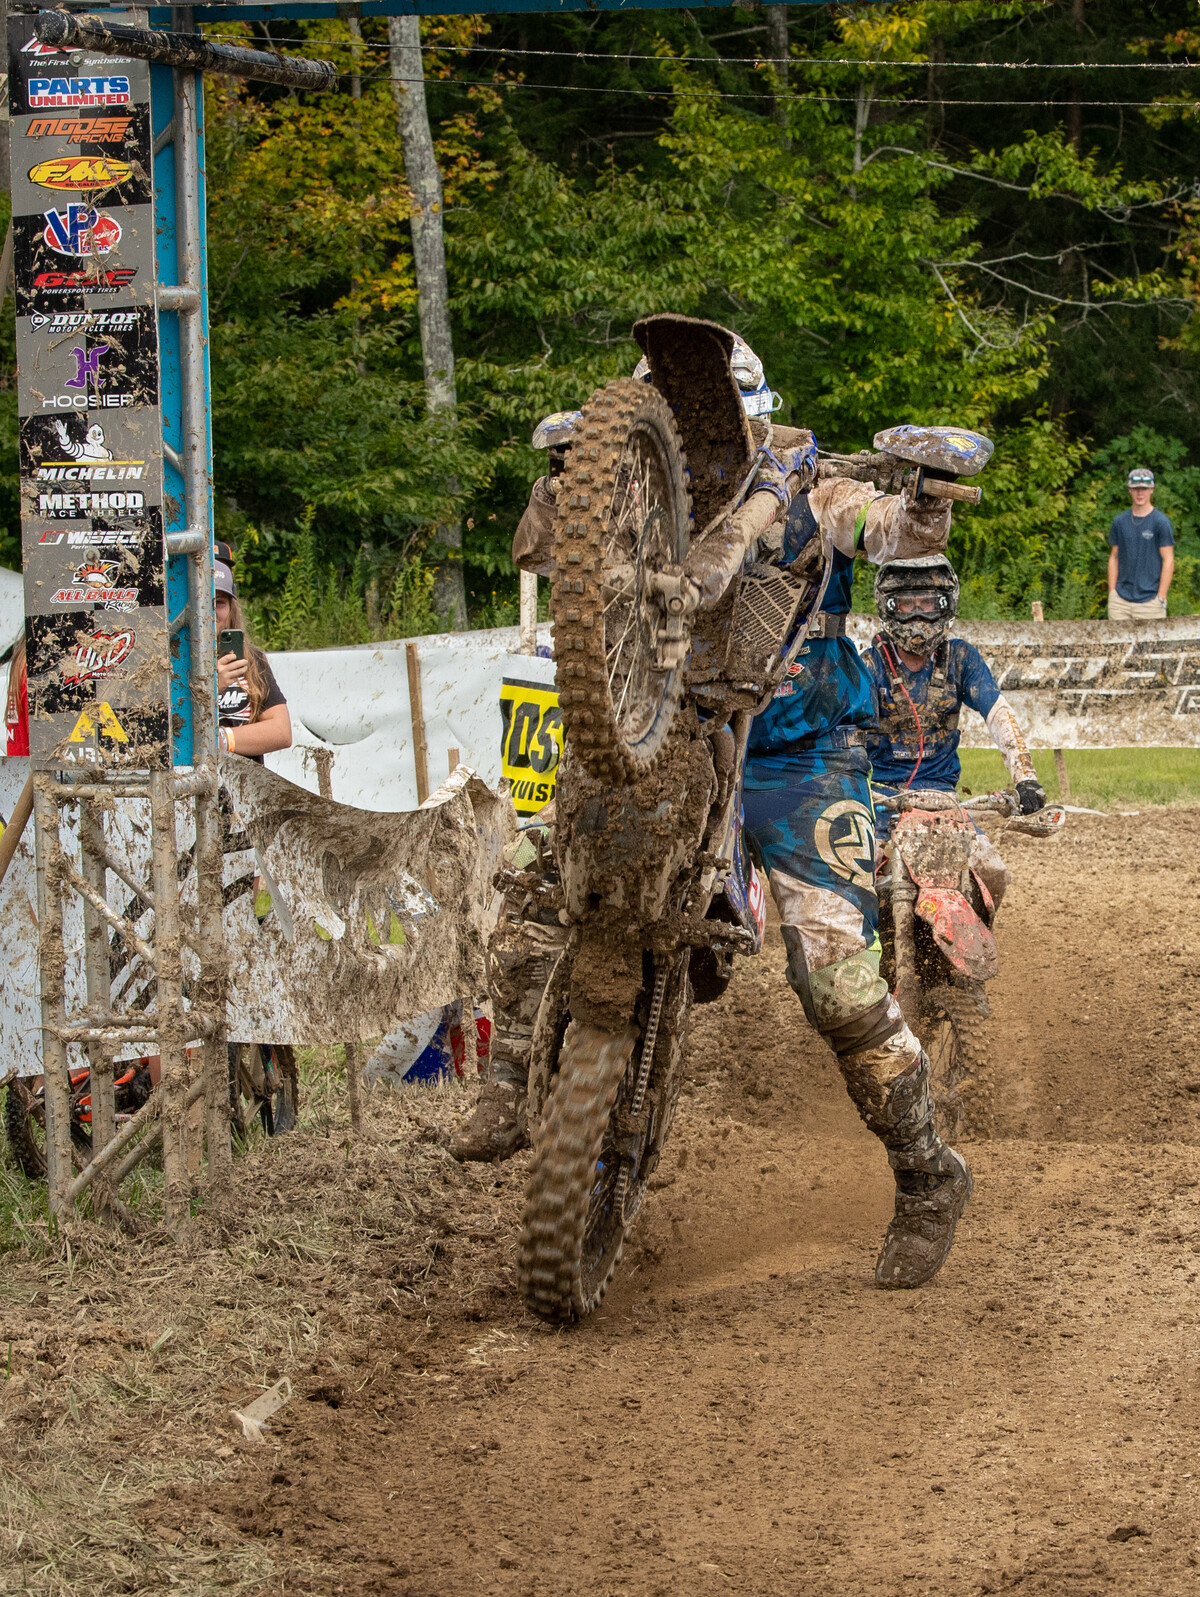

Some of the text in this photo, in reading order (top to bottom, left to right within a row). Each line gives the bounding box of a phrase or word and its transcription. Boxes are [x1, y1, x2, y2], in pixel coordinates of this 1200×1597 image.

[83, 57, 132, 66] Synthetics
[29, 77, 130, 95] PARTS
[30, 94, 130, 107] UNLIMITED
[25, 117, 134, 136] MOOSE
[67, 133, 125, 144] RACING
[30, 160, 132, 183] FMF
[46, 203, 98, 254] VP
[41, 287, 94, 295] POWERSPORTS
[42, 394, 134, 408] HOOSIER
[37, 466, 144, 481] MICHELIN
[39, 492, 144, 510] METHOD
[52, 588, 138, 602] ALL BALLS
